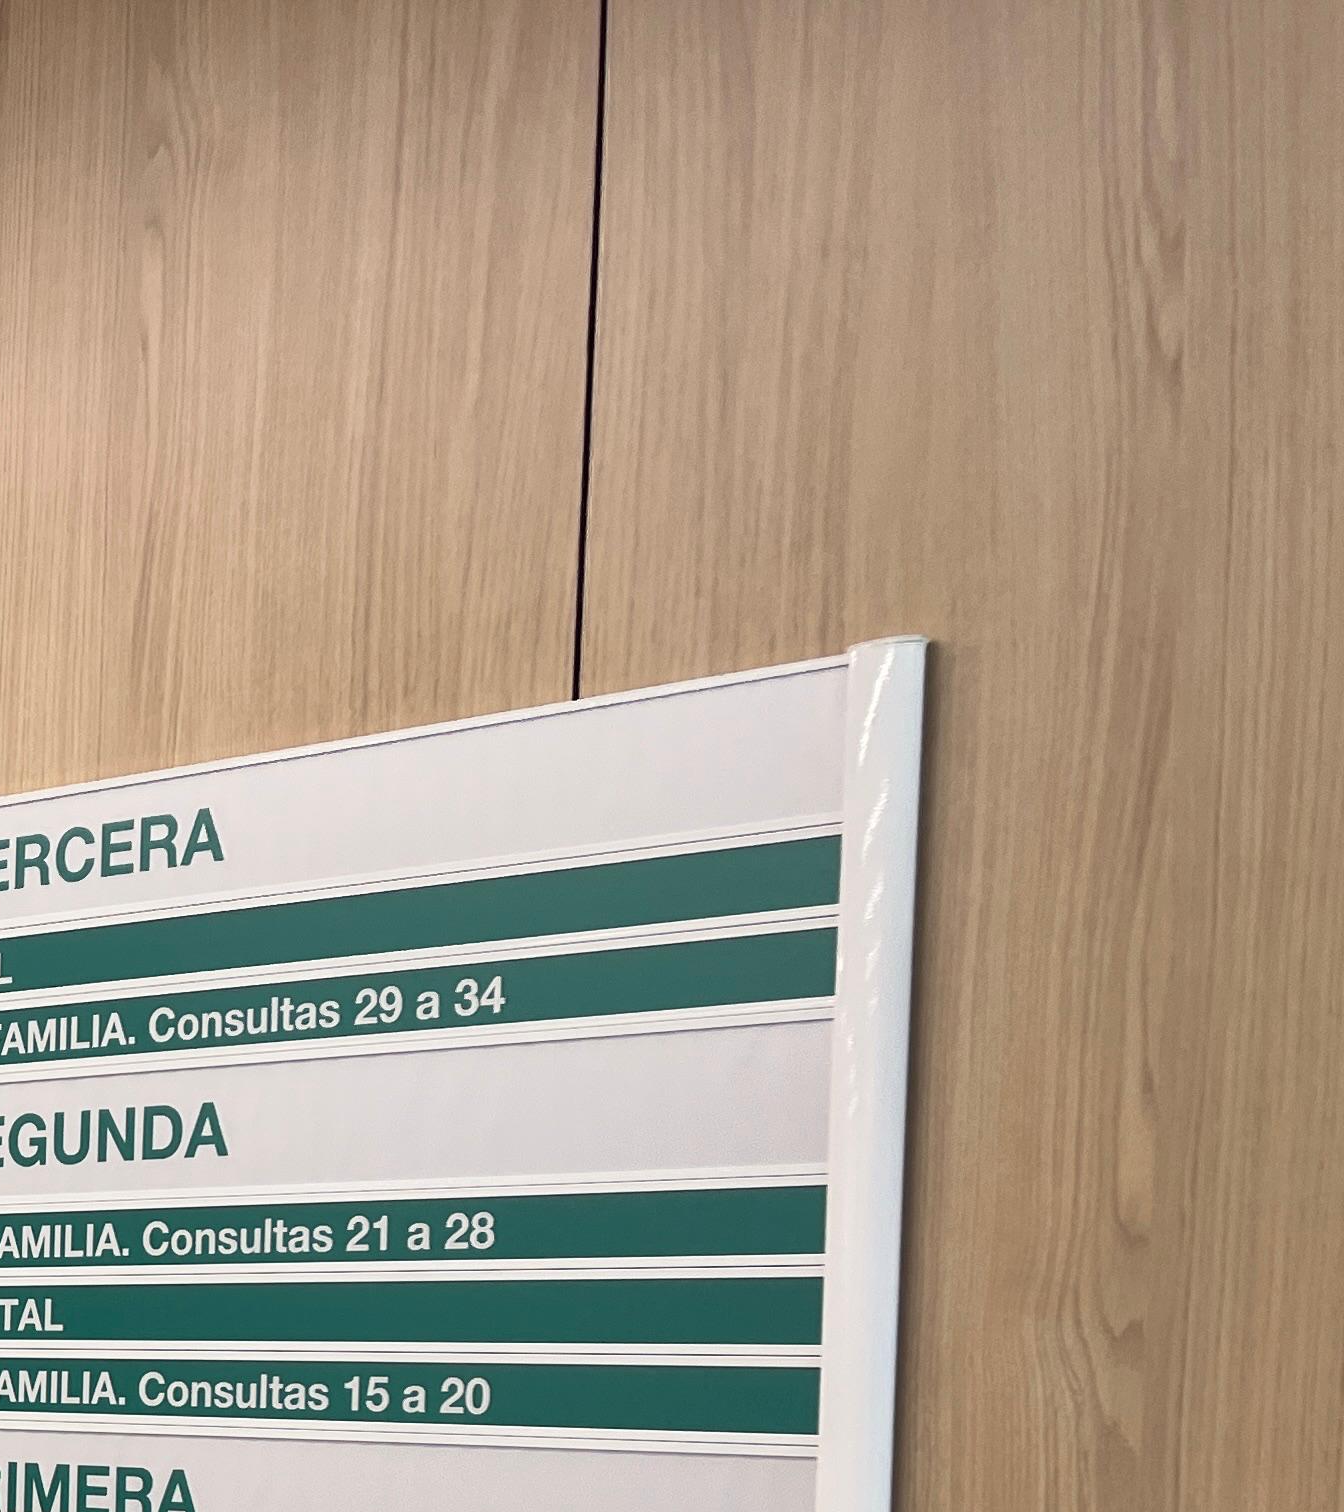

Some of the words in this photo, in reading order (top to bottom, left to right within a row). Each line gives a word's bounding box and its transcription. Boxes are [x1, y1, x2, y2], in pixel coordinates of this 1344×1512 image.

[149, 997, 339, 1042] Consultas
[354, 986, 402, 1025] 29
[416, 992, 439, 1020] a
[455, 976, 505, 1016] 34
[143, 1218, 333, 1256] Consultas
[346, 1216, 387, 1251] 21
[408, 1223, 430, 1250] a
[445, 1212, 494, 1249] 28
[139, 1372, 328, 1410] Consultas
[344, 1376, 389, 1412] 15
[403, 1386, 425, 1413] a
[440, 1377, 490, 1414] 20
